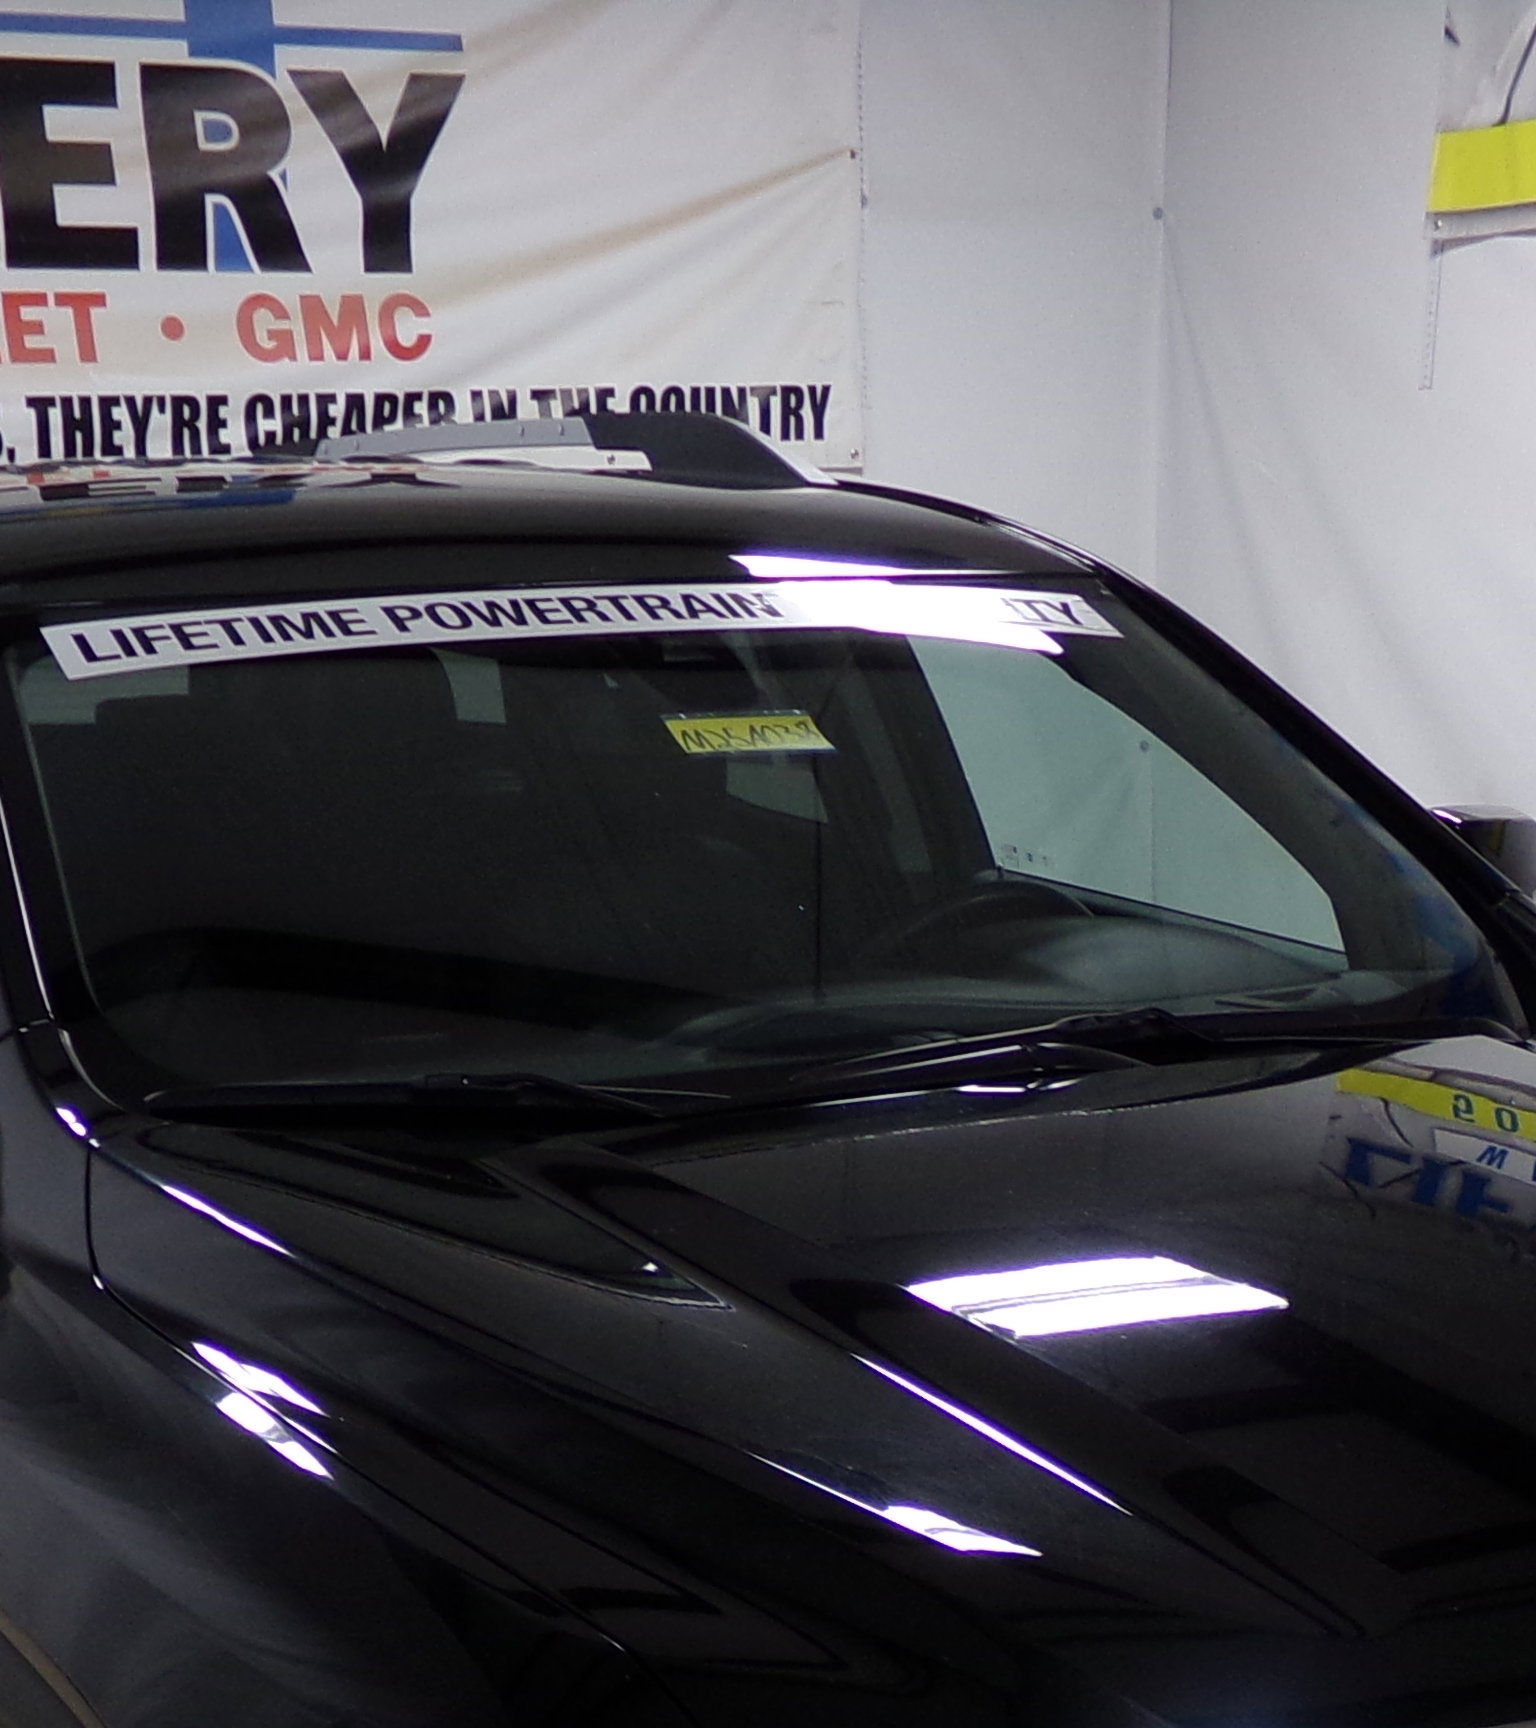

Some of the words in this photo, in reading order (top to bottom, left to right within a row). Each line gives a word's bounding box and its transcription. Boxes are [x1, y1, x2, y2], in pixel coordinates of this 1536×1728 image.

[235, 291, 434, 364] GMC
[26, 394, 232, 460] THEY'RE
[70, 607, 378, 664] LIFETIME
[379, 592, 786, 634] POWERTRAIN
